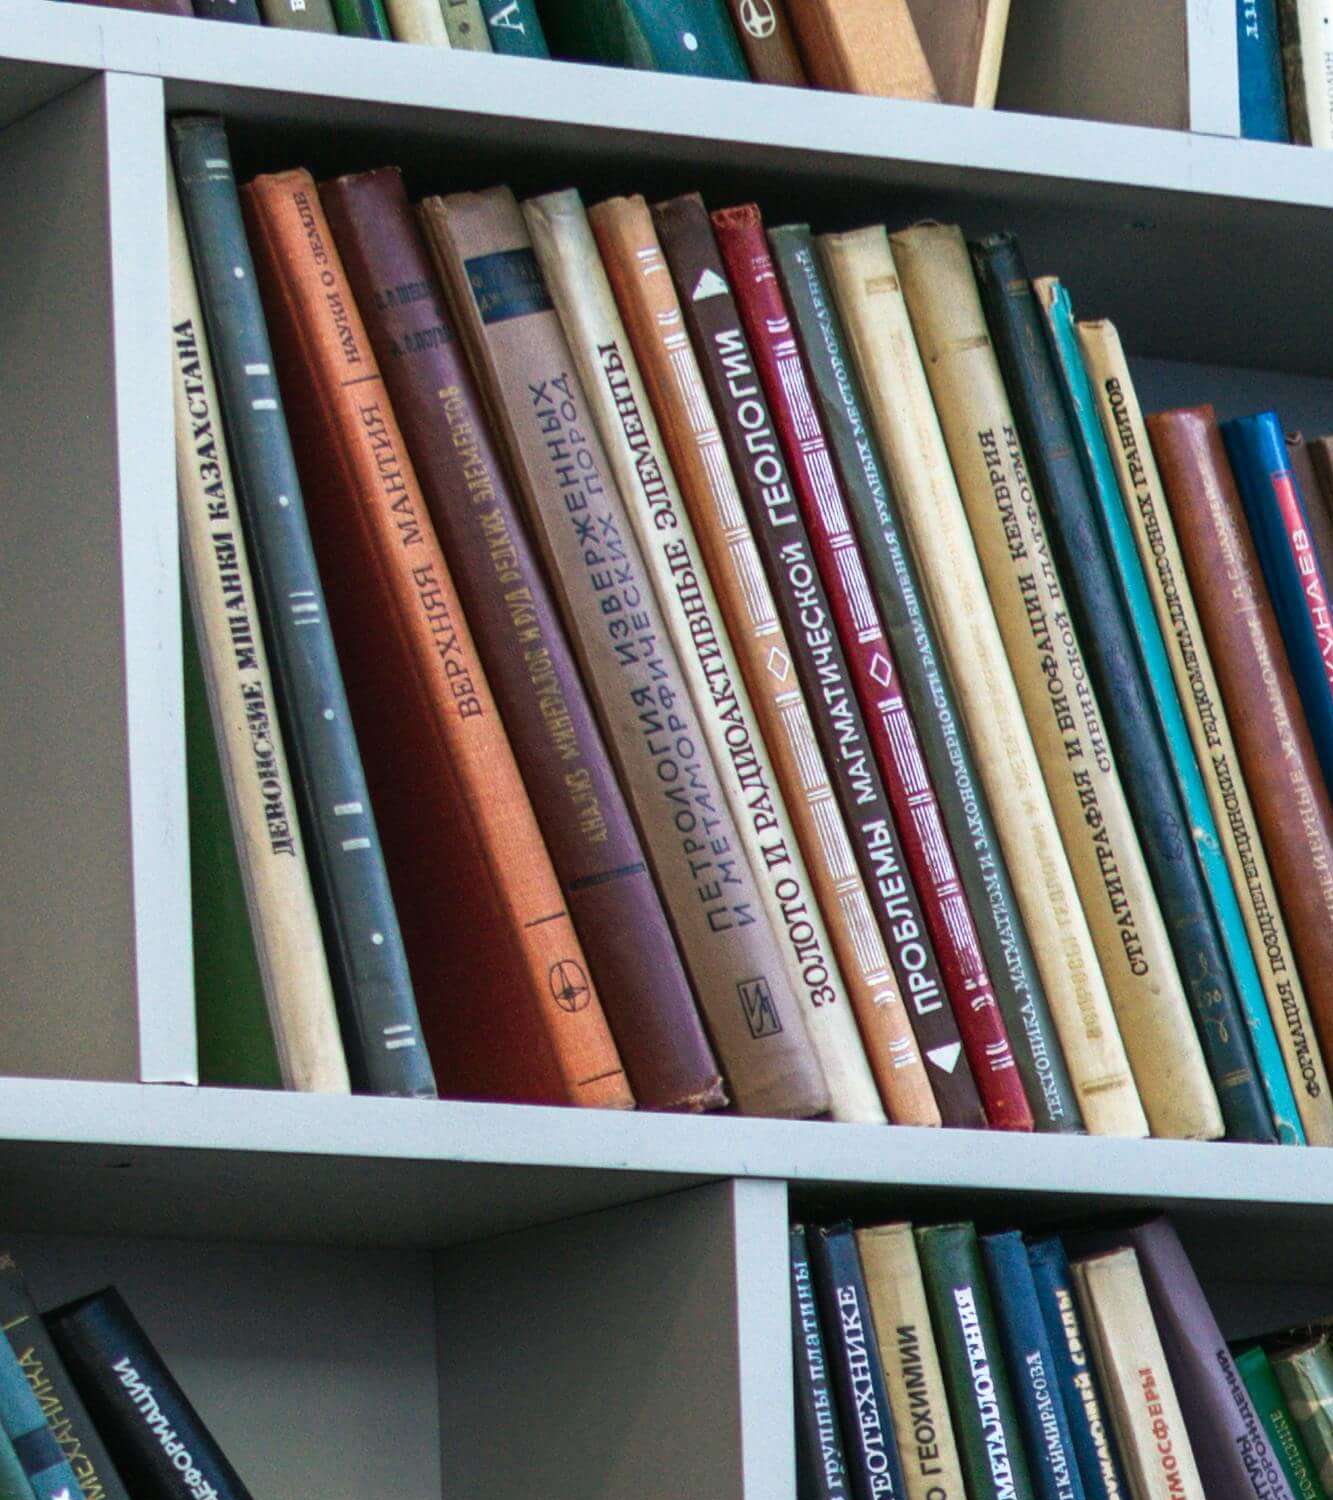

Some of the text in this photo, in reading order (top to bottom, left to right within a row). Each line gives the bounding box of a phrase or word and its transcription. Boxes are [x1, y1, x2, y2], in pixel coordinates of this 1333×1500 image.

[290, 188, 363, 365] НАУКИ О ЗЕМЛЕ
[170, 318, 296, 859] ДЕВОНСКИЕ МШАНКИ КАЗАХСТАНА
[358, 400, 424, 548] МАНТИЯ
[411, 560, 484, 722] ВЕРХНЯЯ
[547, 370, 757, 928] И МЕТАМОРФИЧЕСКИХ ПОРОД
[526, 377, 734, 934] ПЕТРОЛОГИЯ ИЗВЕРЖЕННЫХ
[595, 338, 838, 1009] ЗОЛОТО И РАДИОАКТИВНЫЕ ЭЛЕМЕНТЫ
[712, 325, 945, 1016] ПРОБЛЕМЫ МАГМАТИЧЕСКОЙ ГЕОЛОГИИ
[974, 426, 1152, 978] СТРАТИГРАФИЯ И БИОФАЦИИ КЕМБРИЯ
[1053, 606, 1114, 775] СИБИРСКОЙ
[1102, 376, 1323, 1099] ФОРМАЦИЯ ГРАНИТОВ
[980, 871, 1030, 992] МАГМАТИЗМ
[810, 1386, 848, 1489] группы
[893, 1322, 943, 1477] ГЕОХИМИИ
